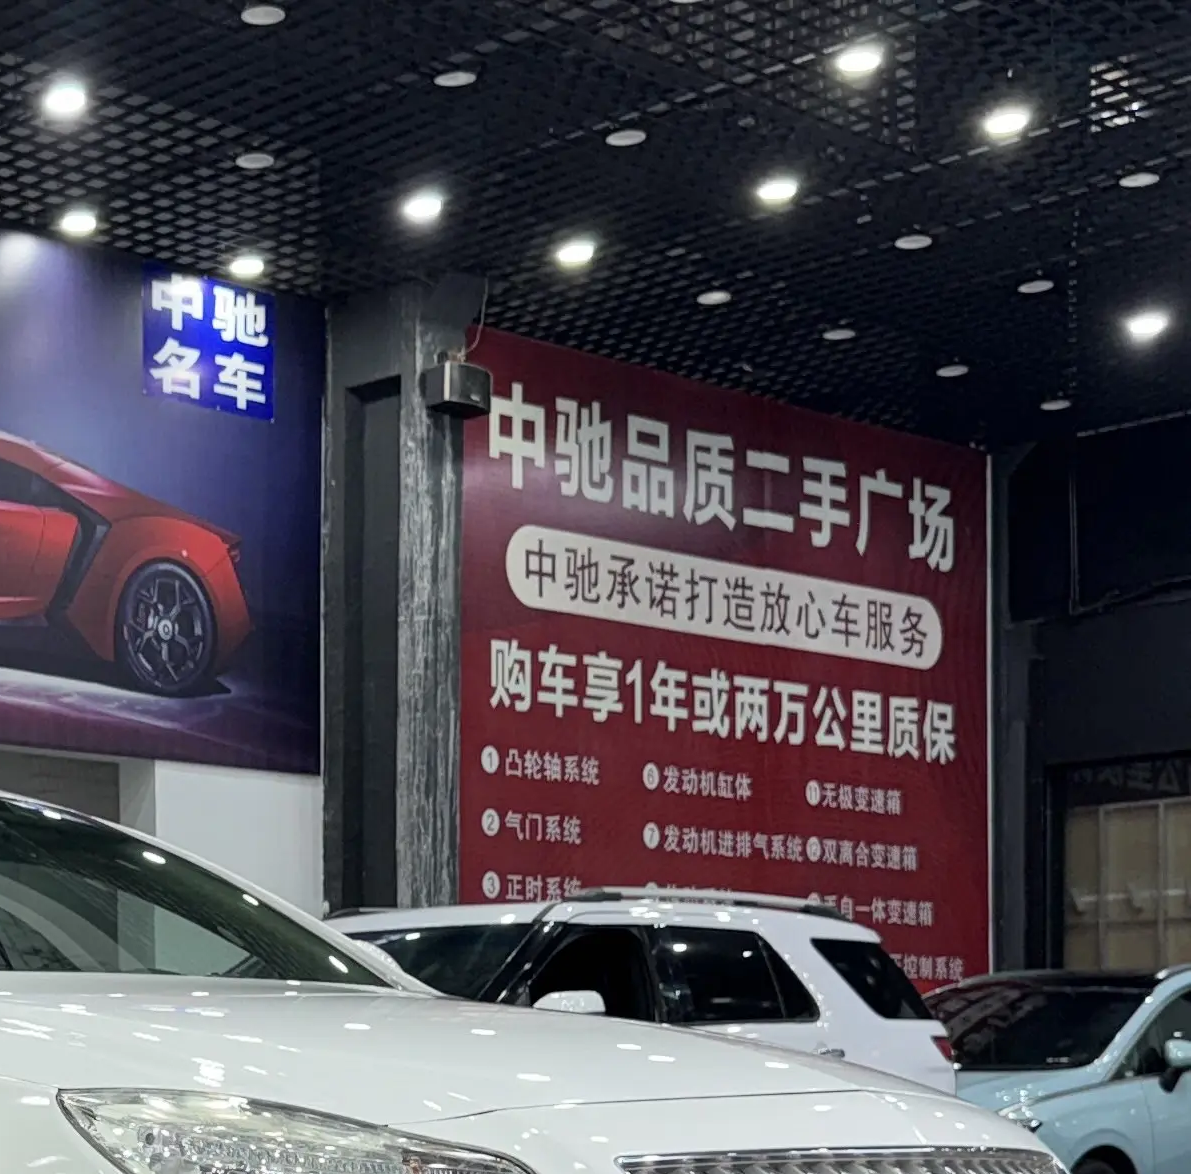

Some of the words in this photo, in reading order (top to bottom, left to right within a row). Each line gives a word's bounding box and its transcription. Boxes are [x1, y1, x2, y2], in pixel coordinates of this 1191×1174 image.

[151, 273, 269, 347] 中驰
[149, 337, 266, 410] 名车
[489, 382, 955, 573] 中驰品质二手广场
[525, 538, 928, 658] 中驰承诺打造放心车服务
[490, 638, 956, 766] 购车享1年或两万公里质保
[505, 748, 600, 785] 凸轮轴系统
[663, 765, 753, 801] 发动机缸体
[505, 810, 582, 844] 气门系统
